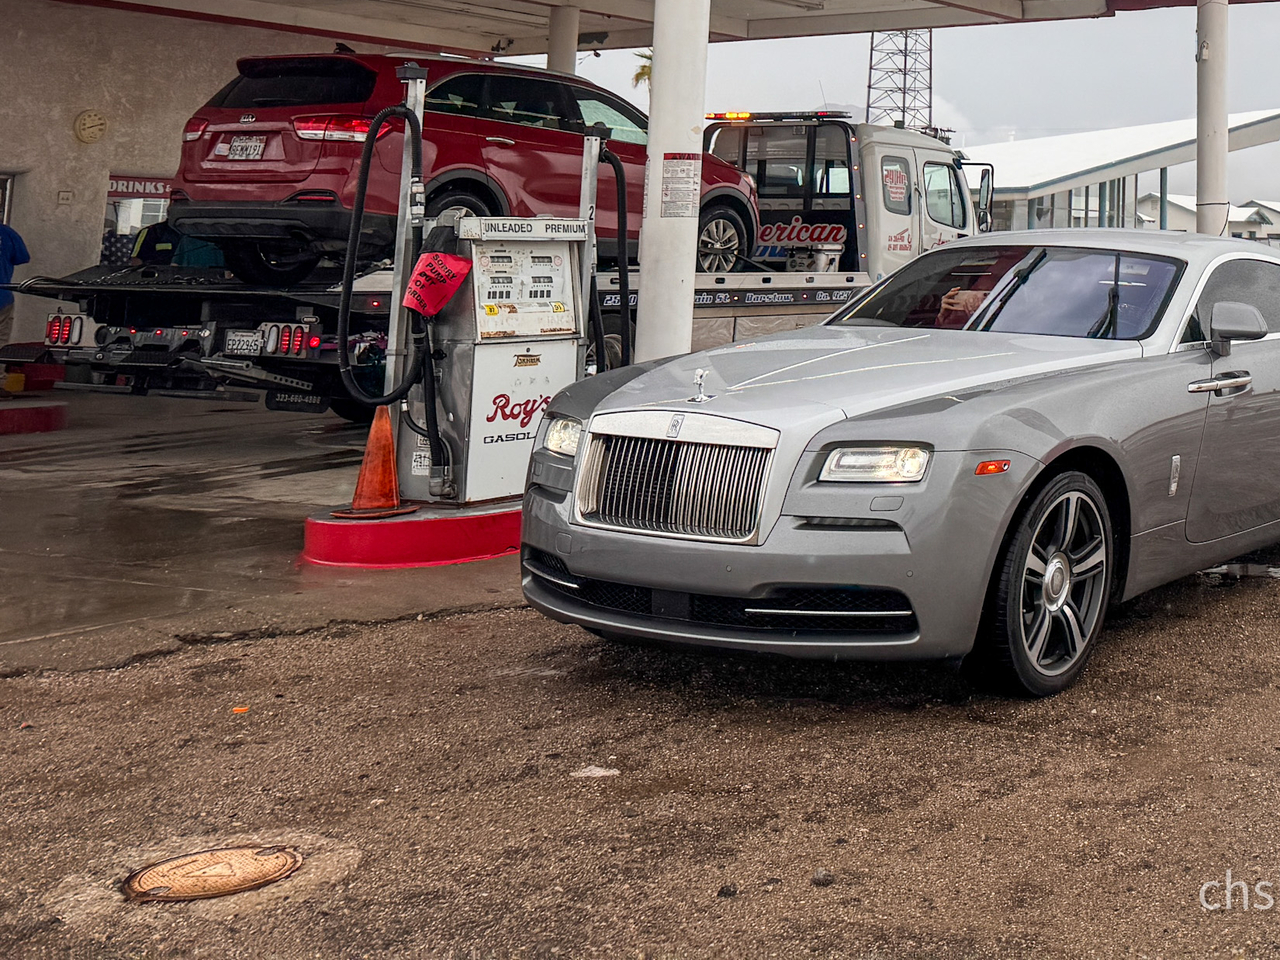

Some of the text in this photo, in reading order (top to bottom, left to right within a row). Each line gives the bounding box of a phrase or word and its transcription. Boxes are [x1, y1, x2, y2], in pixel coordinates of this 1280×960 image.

[108, 180, 165, 194] DRINKS
[588, 205, 595, 221] 2
[484, 222, 586, 234] UNLEADED PREMIUM
[426, 262, 447, 285] PUMP
[432, 253, 458, 280] SORRY
[415, 280, 426, 290] OF
[486, 393, 552, 428] Roy's
